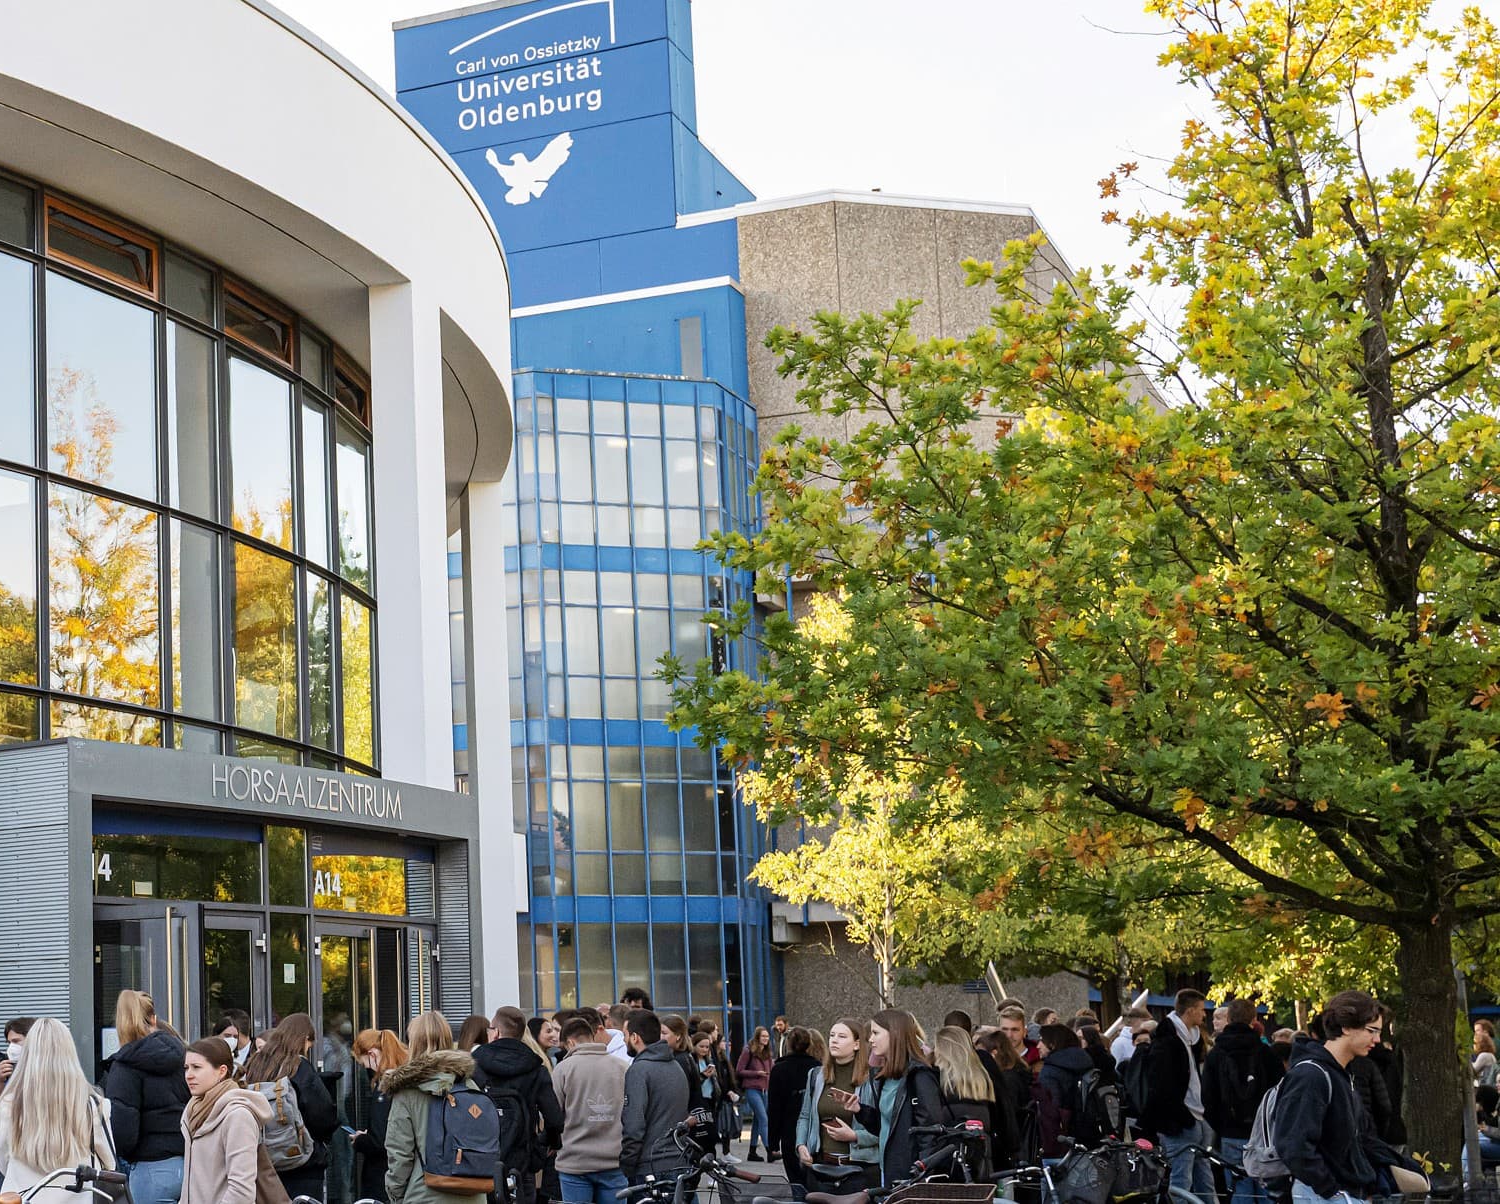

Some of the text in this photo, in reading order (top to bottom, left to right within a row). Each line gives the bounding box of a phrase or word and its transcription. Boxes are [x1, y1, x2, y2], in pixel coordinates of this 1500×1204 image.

[455, 35, 602, 75] Carl von Ossietzky
[457, 56, 602, 103] Universität
[458, 88, 602, 131] Oldenburg
[211, 762, 403, 821] HÖRSAALZENTRUM
[314, 870, 342, 898] A14
